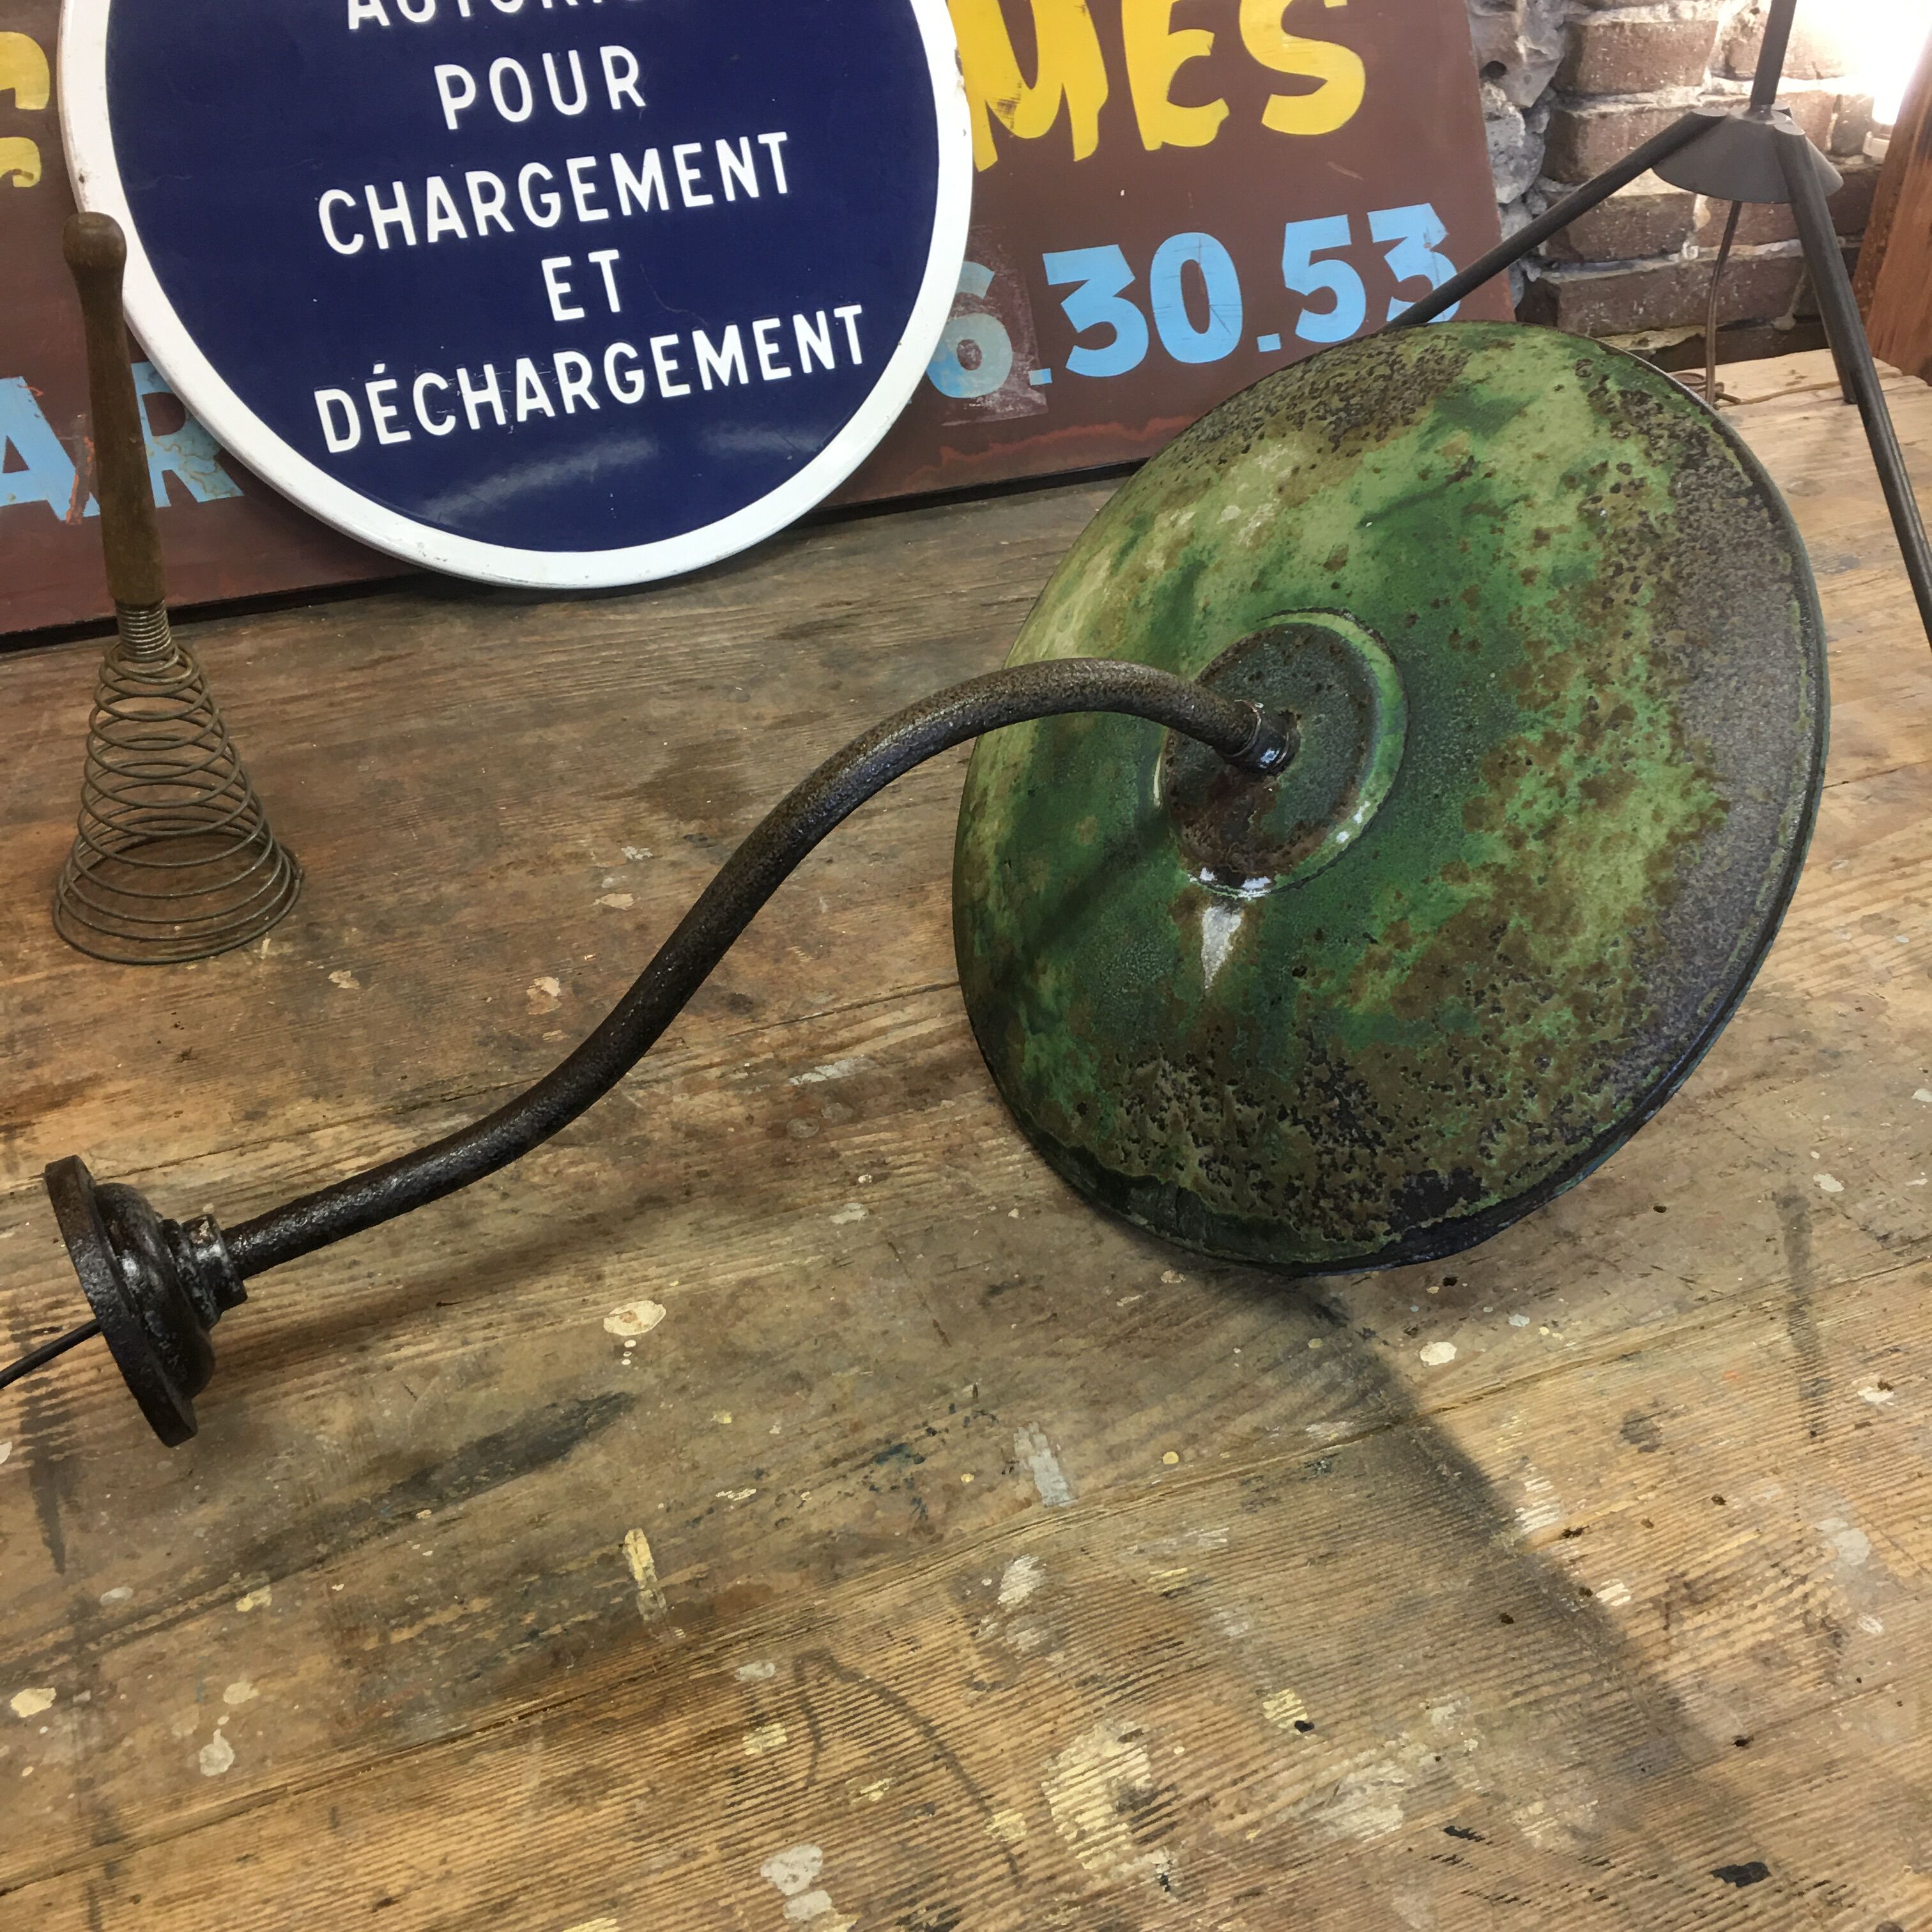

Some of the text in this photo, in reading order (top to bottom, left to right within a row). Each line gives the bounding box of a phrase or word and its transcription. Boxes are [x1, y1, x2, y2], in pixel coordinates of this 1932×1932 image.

[434, 45, 646, 130] POUR
[318, 132, 788, 255] CHARGEMENT
[541, 249, 621, 321] ET
[314, 304, 863, 454] DÉCHARGEMENT
